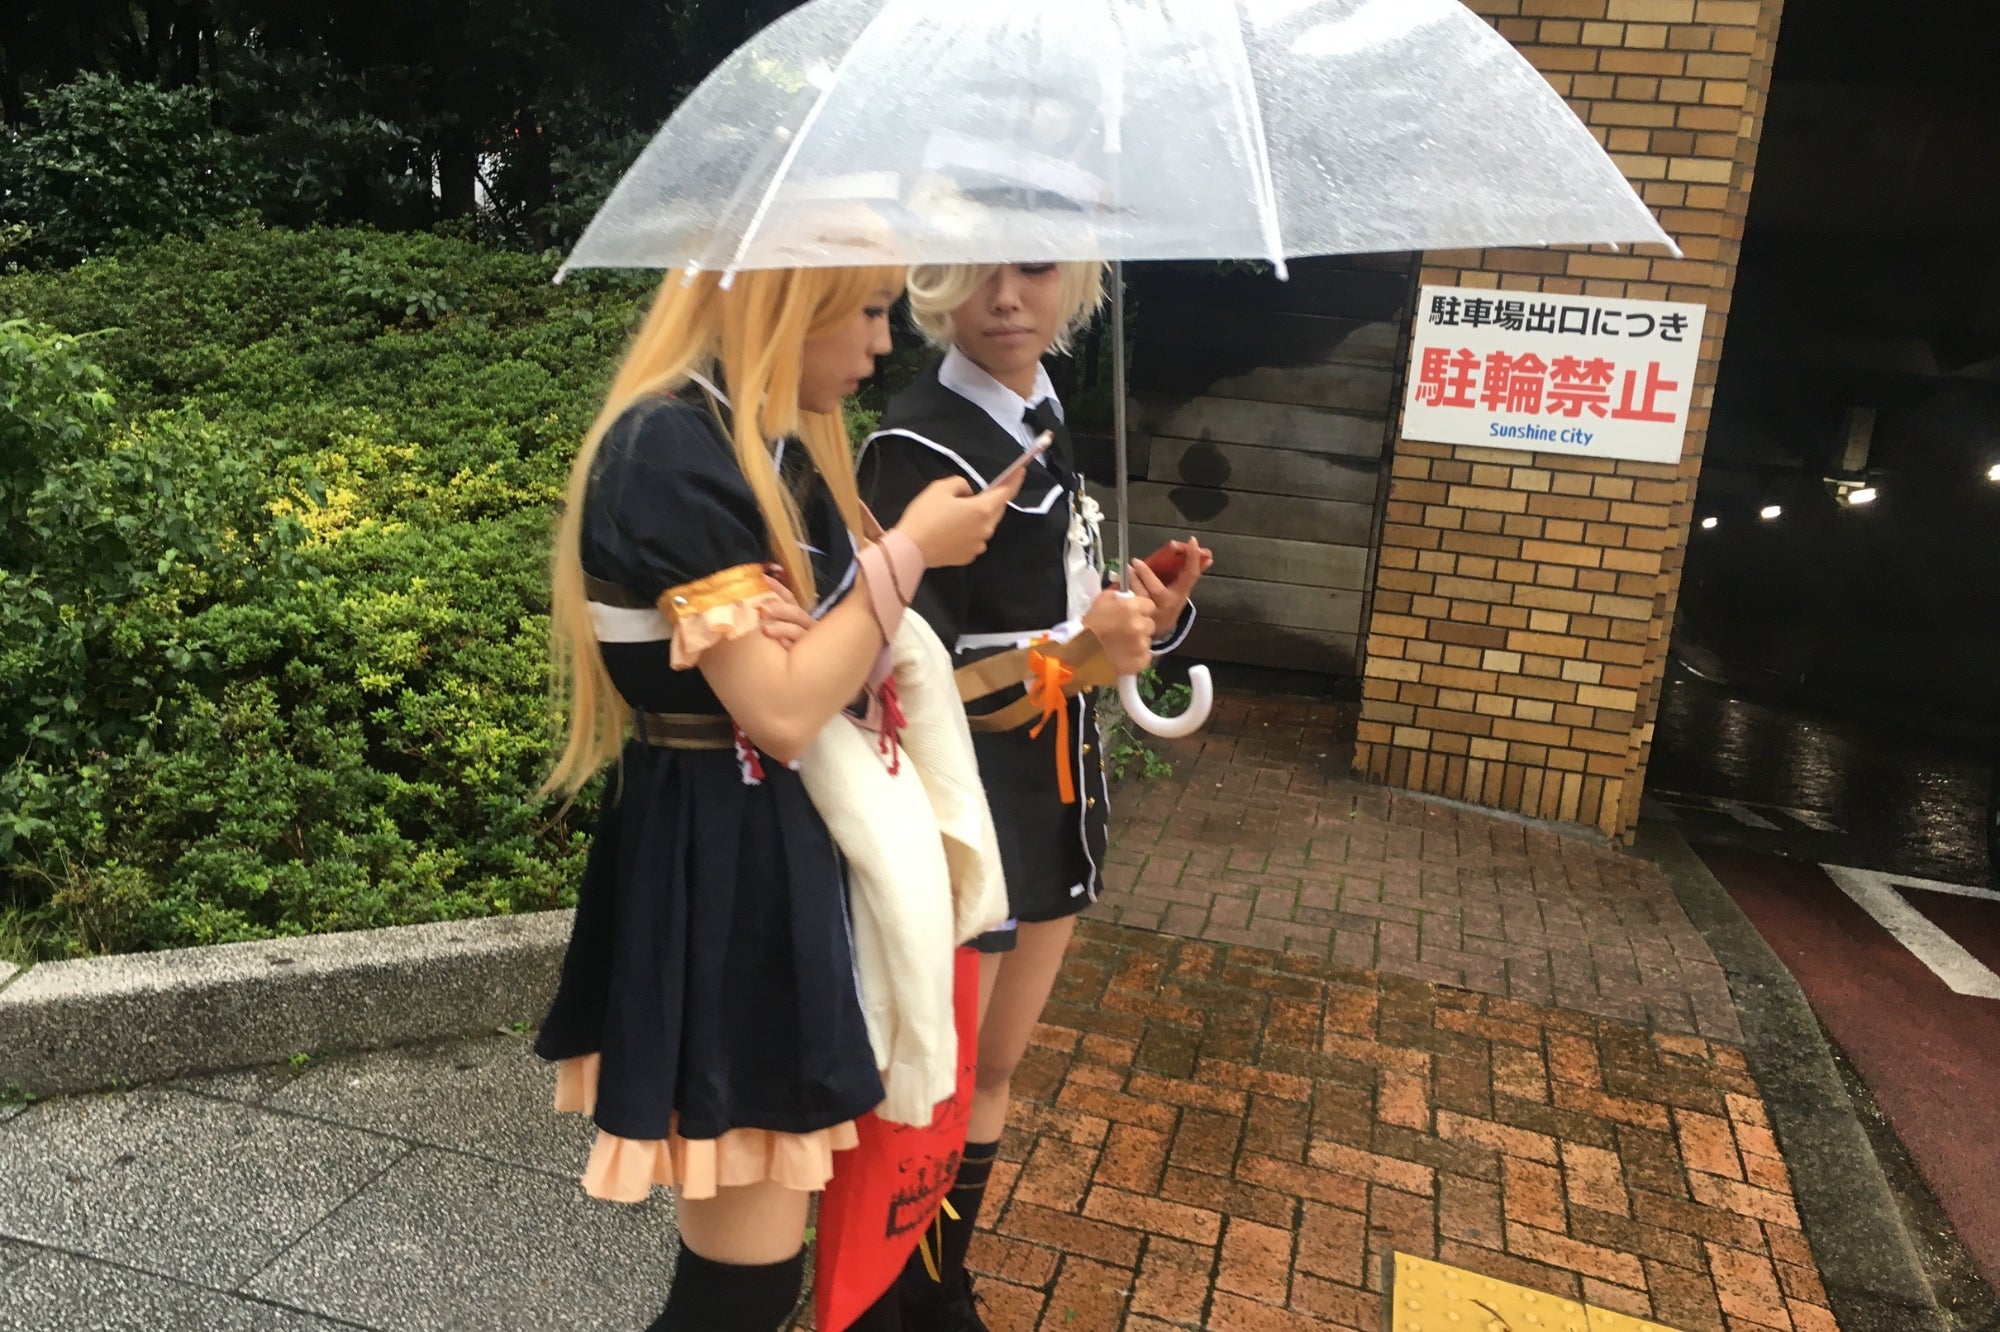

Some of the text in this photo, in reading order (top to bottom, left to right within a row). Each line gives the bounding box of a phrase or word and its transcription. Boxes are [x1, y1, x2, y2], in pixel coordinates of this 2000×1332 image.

[1428, 295, 1688, 342] 駐車場出口につき
[1414, 347, 1678, 423] 駐輪禁止
[1489, 422, 1594, 446] Sunshine City
